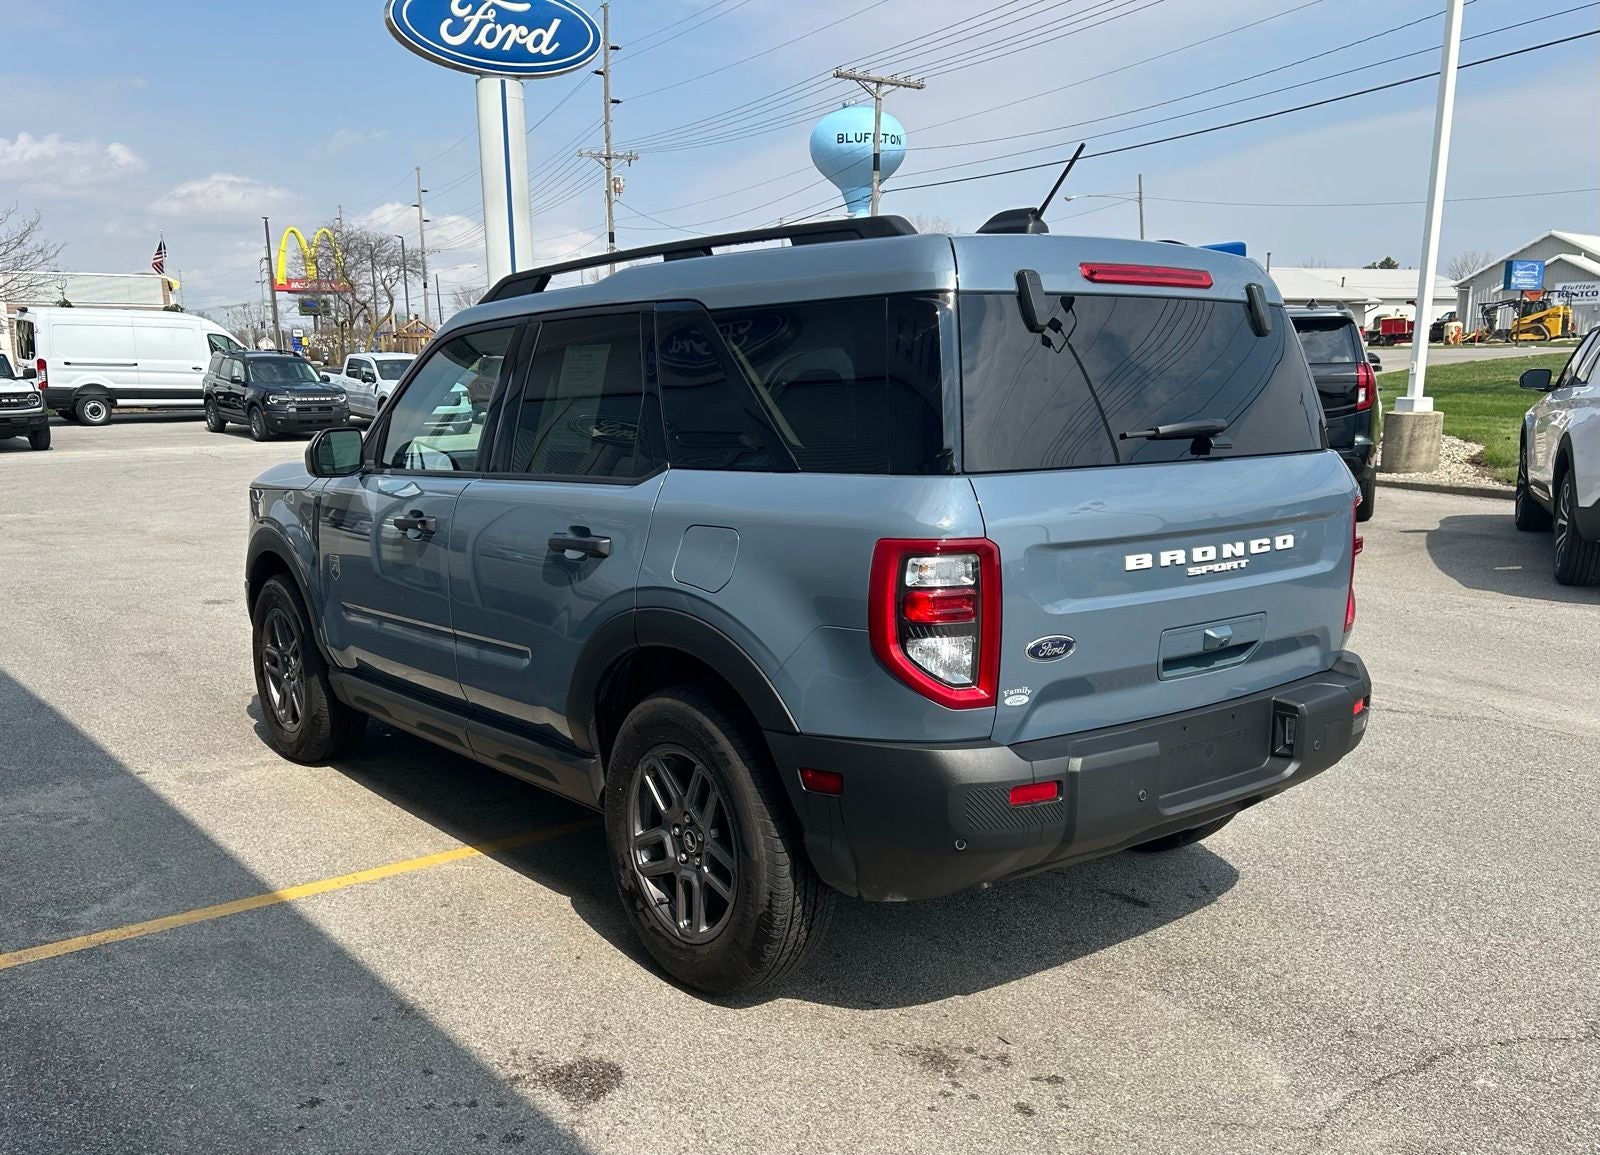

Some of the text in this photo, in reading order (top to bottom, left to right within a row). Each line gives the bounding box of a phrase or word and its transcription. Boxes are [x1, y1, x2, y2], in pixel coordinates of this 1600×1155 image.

[440, 0, 561, 55] Ford
[836, 132, 902, 146] BLUFTON
[1125, 534, 1294, 571] BRONCO
[1187, 559, 1249, 577] SPORT
[1038, 641, 1067, 657] Ford
[1003, 686, 1033, 698] Family
